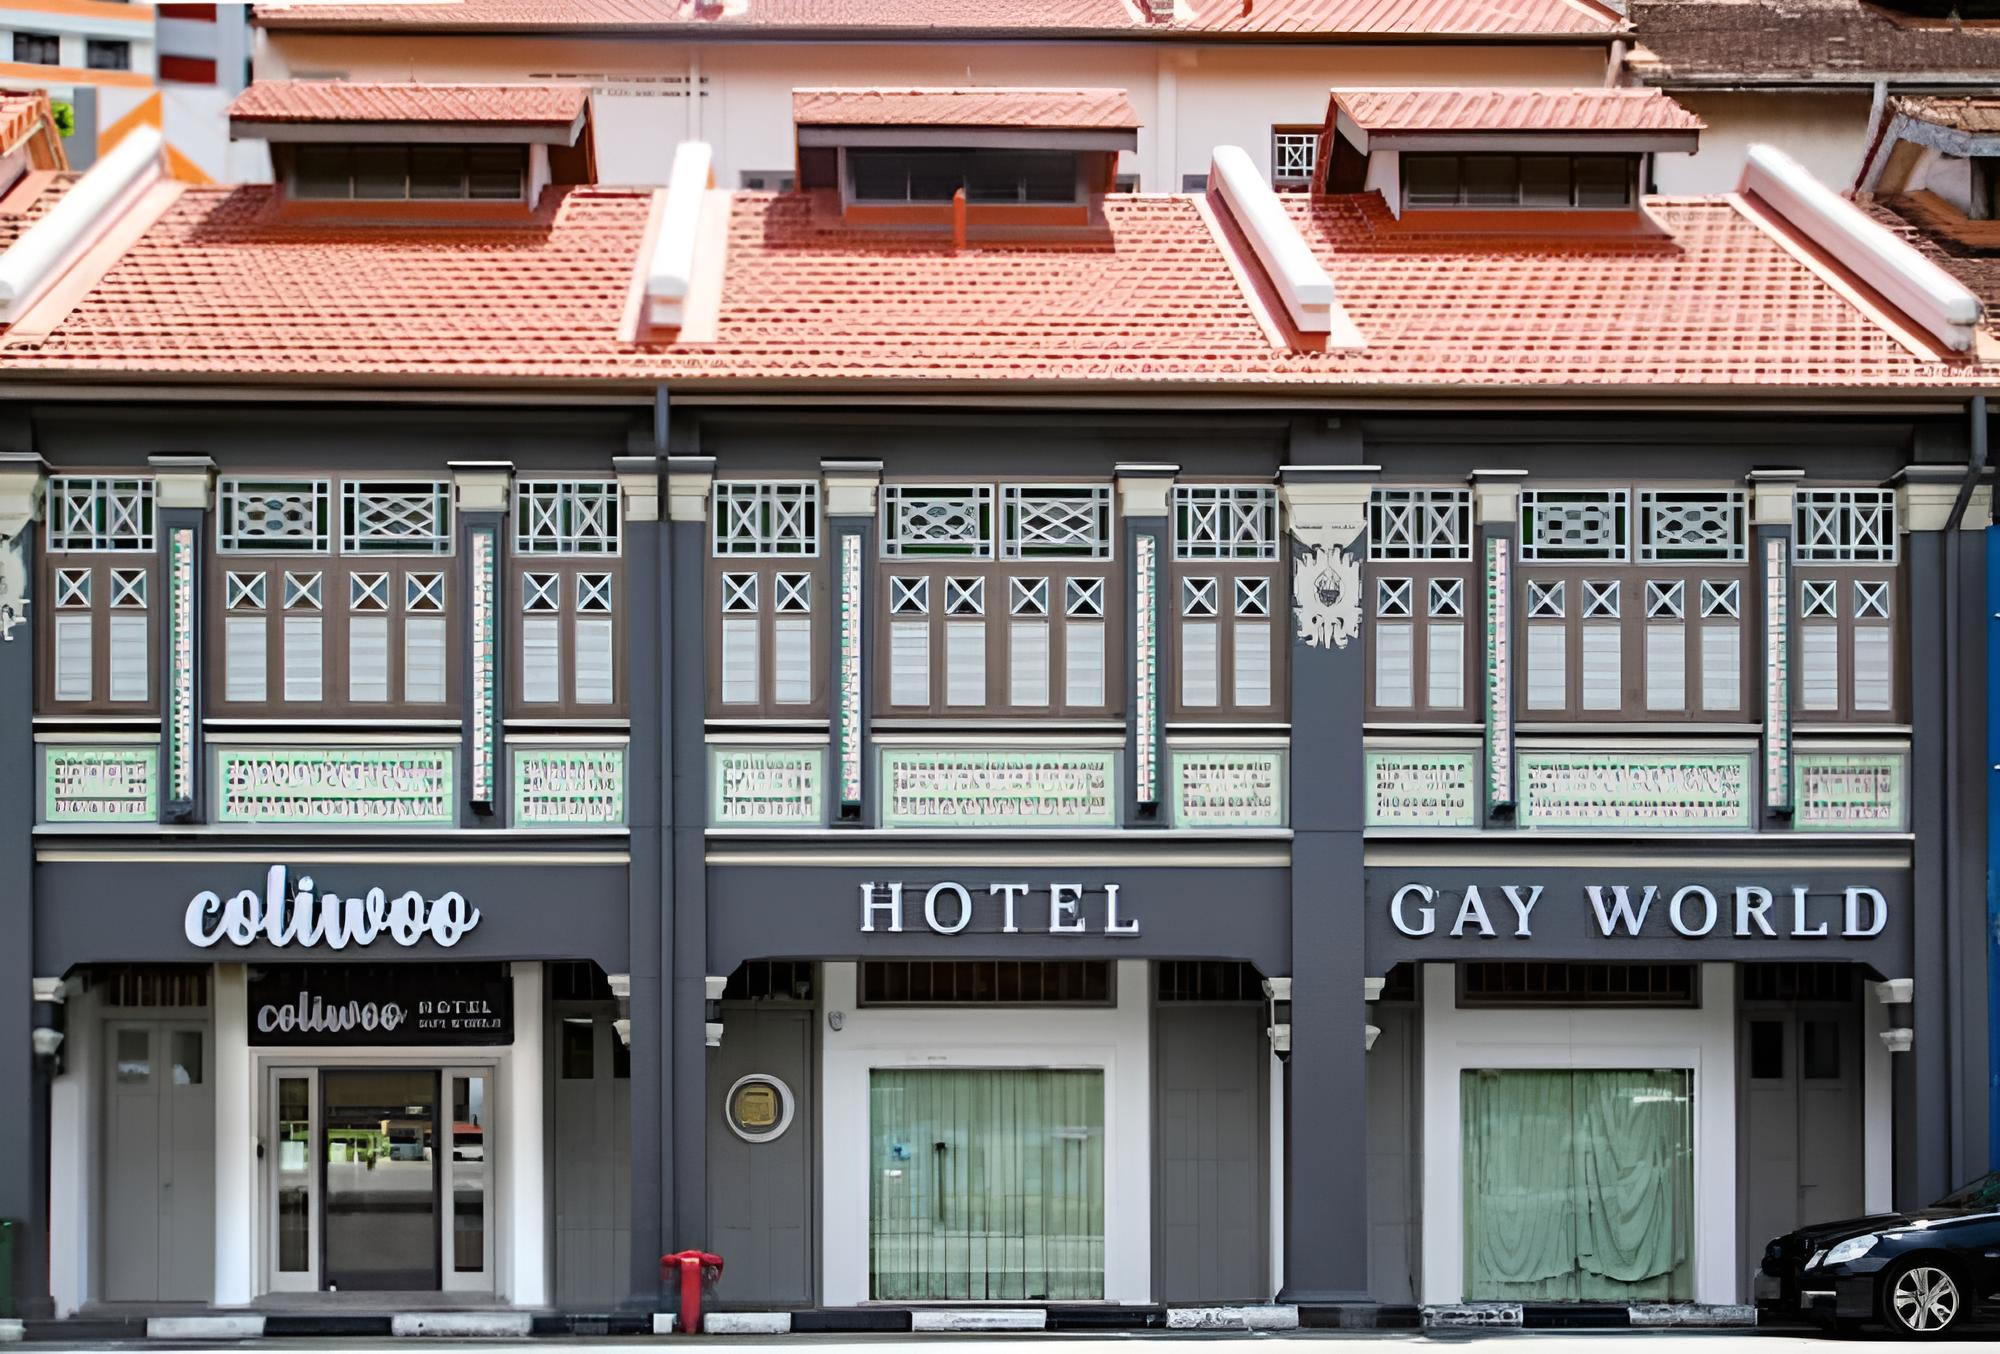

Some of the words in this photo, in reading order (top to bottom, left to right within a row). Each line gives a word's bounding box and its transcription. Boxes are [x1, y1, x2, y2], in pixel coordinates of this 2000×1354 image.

[184, 864, 481, 950] coliwoo
[860, 881, 1140, 936] HOTEL
[1391, 884, 1545, 937] GAY
[1585, 884, 1889, 937] WORLD
[257, 990, 408, 1033] coliwoo
